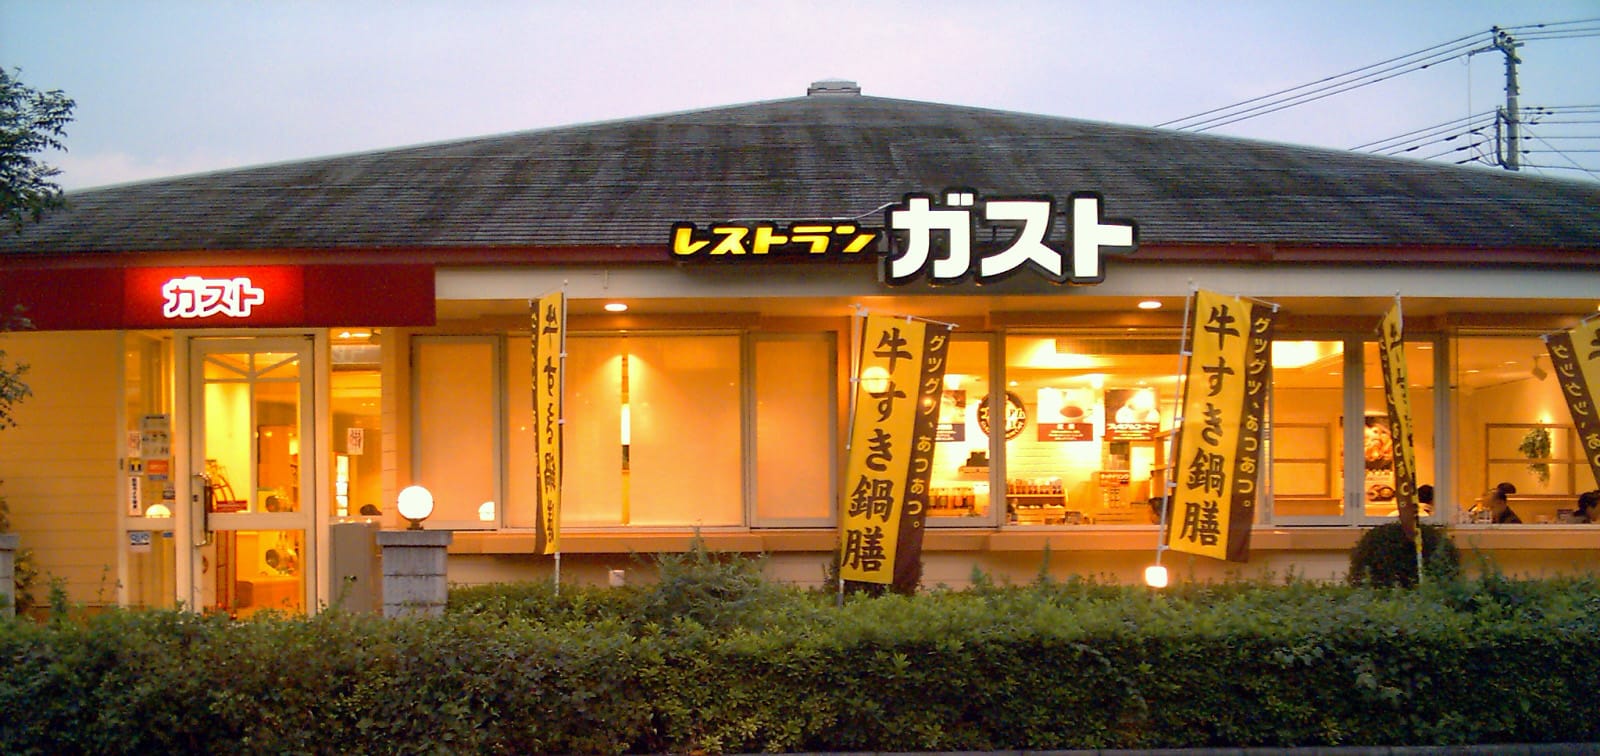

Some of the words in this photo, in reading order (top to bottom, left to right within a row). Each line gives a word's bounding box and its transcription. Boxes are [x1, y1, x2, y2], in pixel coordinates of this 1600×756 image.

[163, 277, 264, 318] ガスト
[673, 226, 876, 254] レストラン
[892, 193, 1133, 279] ガスト
[842, 327, 913, 574] 牛すき鍋膳
[1179, 304, 1241, 547] 牛すき鍋膳
[1238, 316, 1271, 509] グツグツ、あつあつ。
